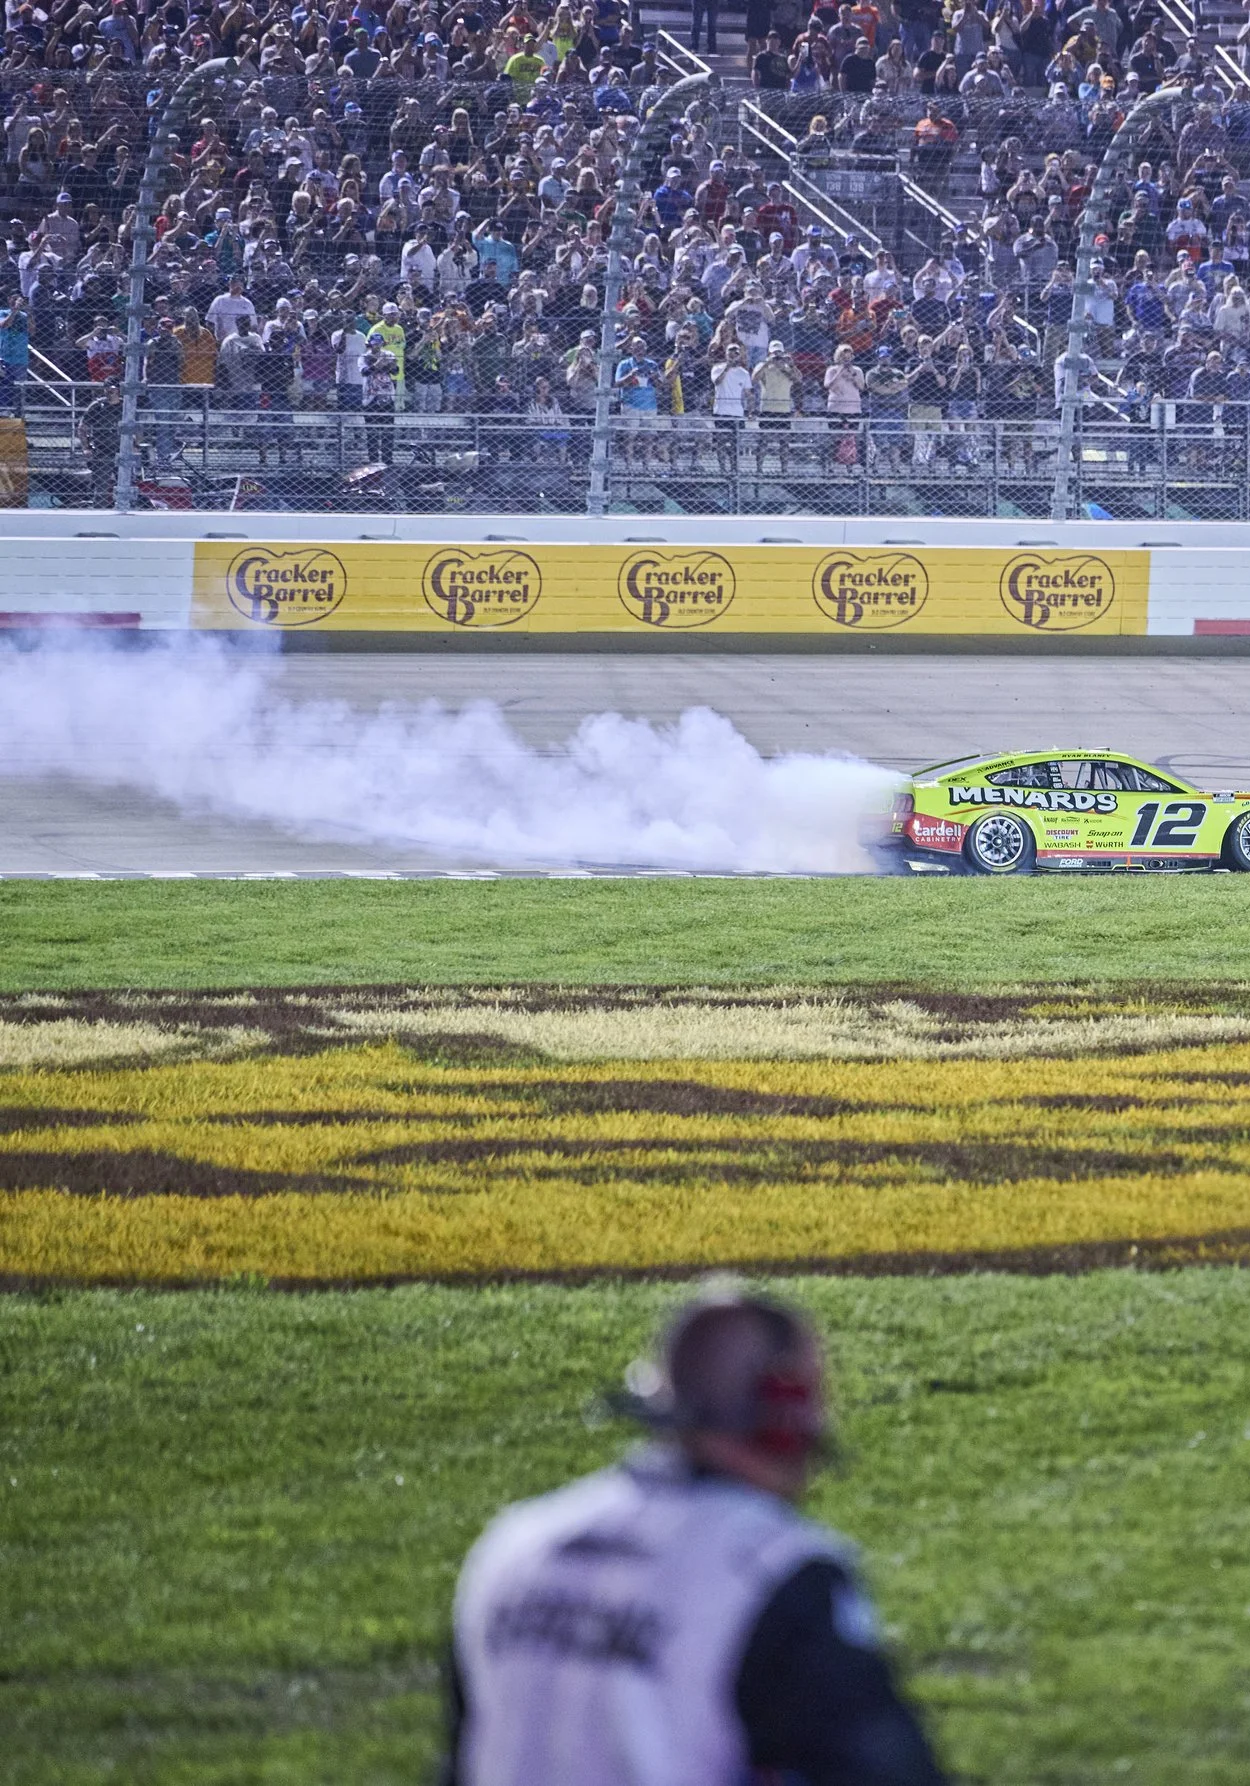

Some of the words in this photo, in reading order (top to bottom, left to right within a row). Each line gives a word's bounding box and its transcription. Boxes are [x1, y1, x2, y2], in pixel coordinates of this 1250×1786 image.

[236, 557, 334, 600] Cracker
[431, 558, 528, 600] Cracker
[626, 560, 723, 602] Cracker
[821, 561, 916, 603] Cracker
[1008, 563, 1102, 604] Cracker
[251, 583, 334, 622] Barrel
[446, 584, 529, 624] Barrel
[642, 585, 723, 625] Barrel
[836, 587, 916, 625] Barrel
[1024, 588, 1103, 627] Barrel
[985, 760, 1015, 770] ADVANCE
[949, 787, 1118, 814] MENARDS
[892, 822, 903, 833] 12
[913, 820, 961, 836] cardell
[1129, 802, 1207, 847] 12
